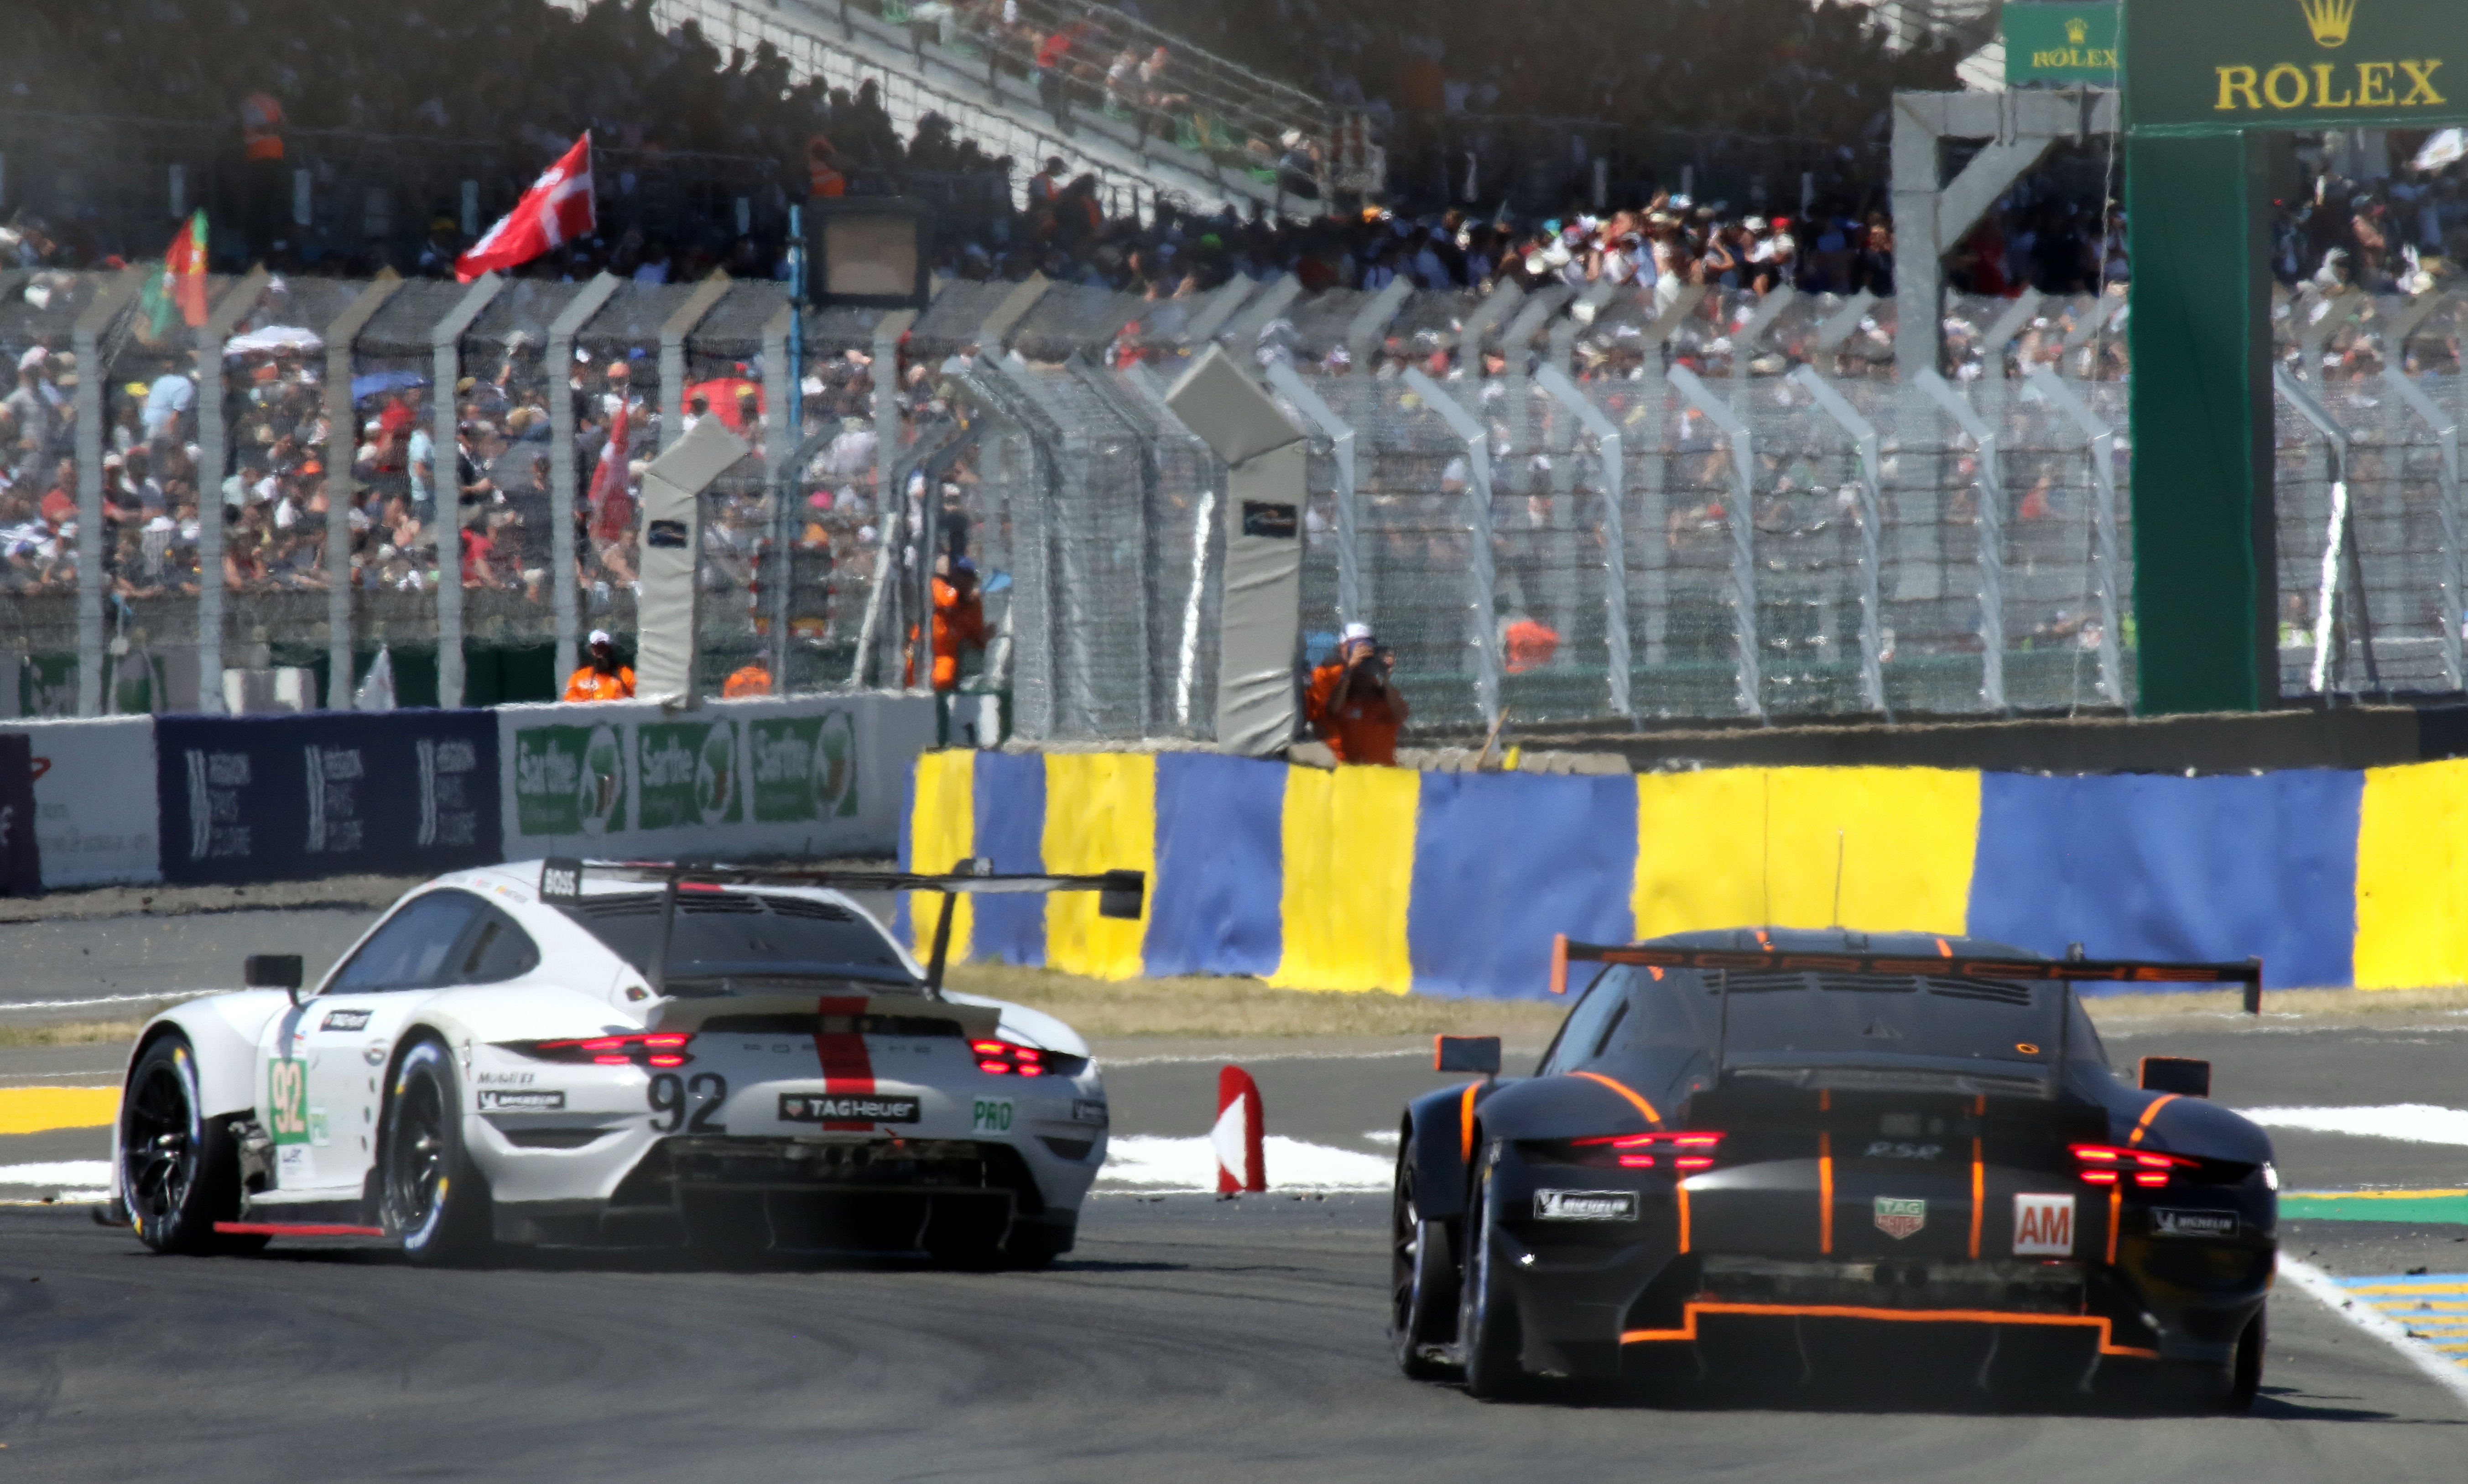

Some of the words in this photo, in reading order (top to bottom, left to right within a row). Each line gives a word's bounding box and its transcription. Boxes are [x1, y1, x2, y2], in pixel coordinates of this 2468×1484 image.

[2033, 47, 2120, 68] ROLEX
[2214, 59, 2447, 111] ROLEX
[518, 740, 578, 794] Sarthe
[641, 733, 694, 787] Sarthe
[545, 868, 575, 896] BOSS
[274, 1061, 305, 1134] 92
[647, 1073, 727, 1134] 92
[974, 1100, 1012, 1131] PRO
[1881, 1202, 1921, 1214] TAG
[2018, 1206, 2069, 1245] AM
